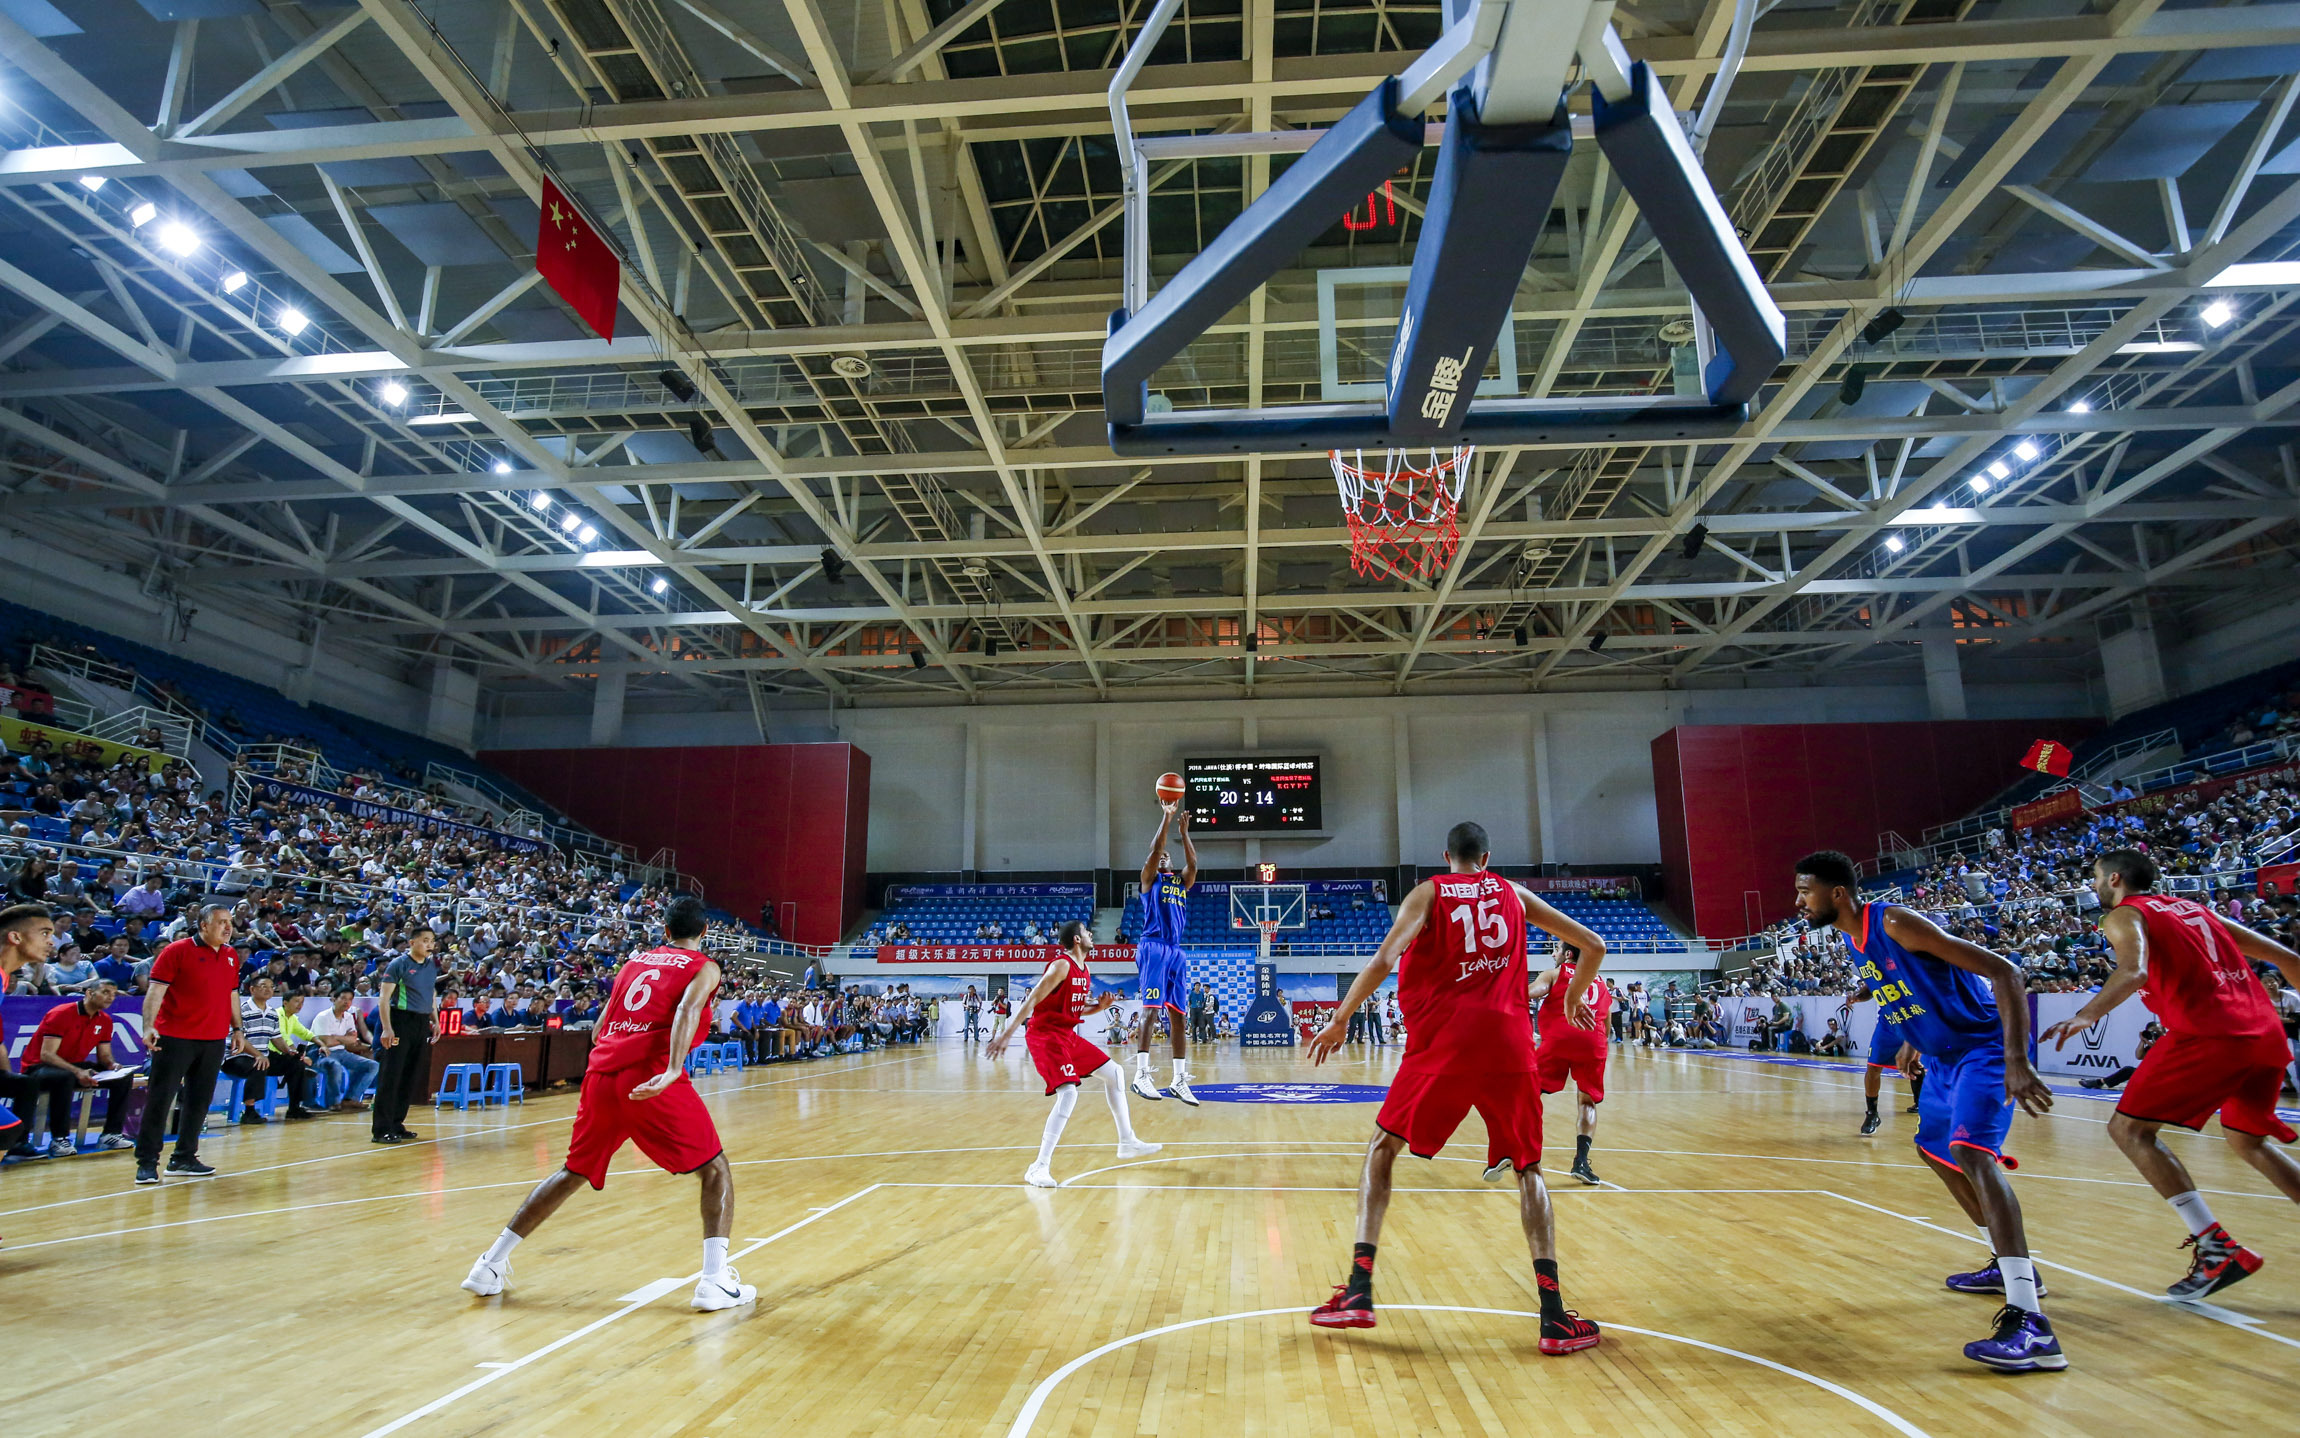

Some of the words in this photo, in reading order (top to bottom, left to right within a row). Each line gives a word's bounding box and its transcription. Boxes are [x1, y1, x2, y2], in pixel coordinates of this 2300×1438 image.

[1421, 346, 1474, 428] 金陵
[1219, 791, 1238, 805] 20
[1256, 790, 1274, 805] 14
[2173, 789, 2199, 804] 208
[352, 801, 388, 823] JAVA
[1260, 864, 1276, 872] 9:45
[1263, 871, 1273, 881] 10
[1201, 884, 1228, 893] JAVA
[1450, 898, 1509, 954] 15
[2183, 916, 2219, 963] 7
[895, 948, 957, 961] 超级大乐透
[961, 947, 1047, 960] 2元可中1000万
[1055, 947, 1138, 959] 3中1600万
[1488, 954, 1510, 974] PLAY
[1866, 959, 1884, 982] 8
[624, 968, 661, 1011] 6
[1261, 966, 1271, 997] 金陵体育
[1145, 987, 1160, 1000] 20
[2067, 1054, 2121, 1068] JAVA
